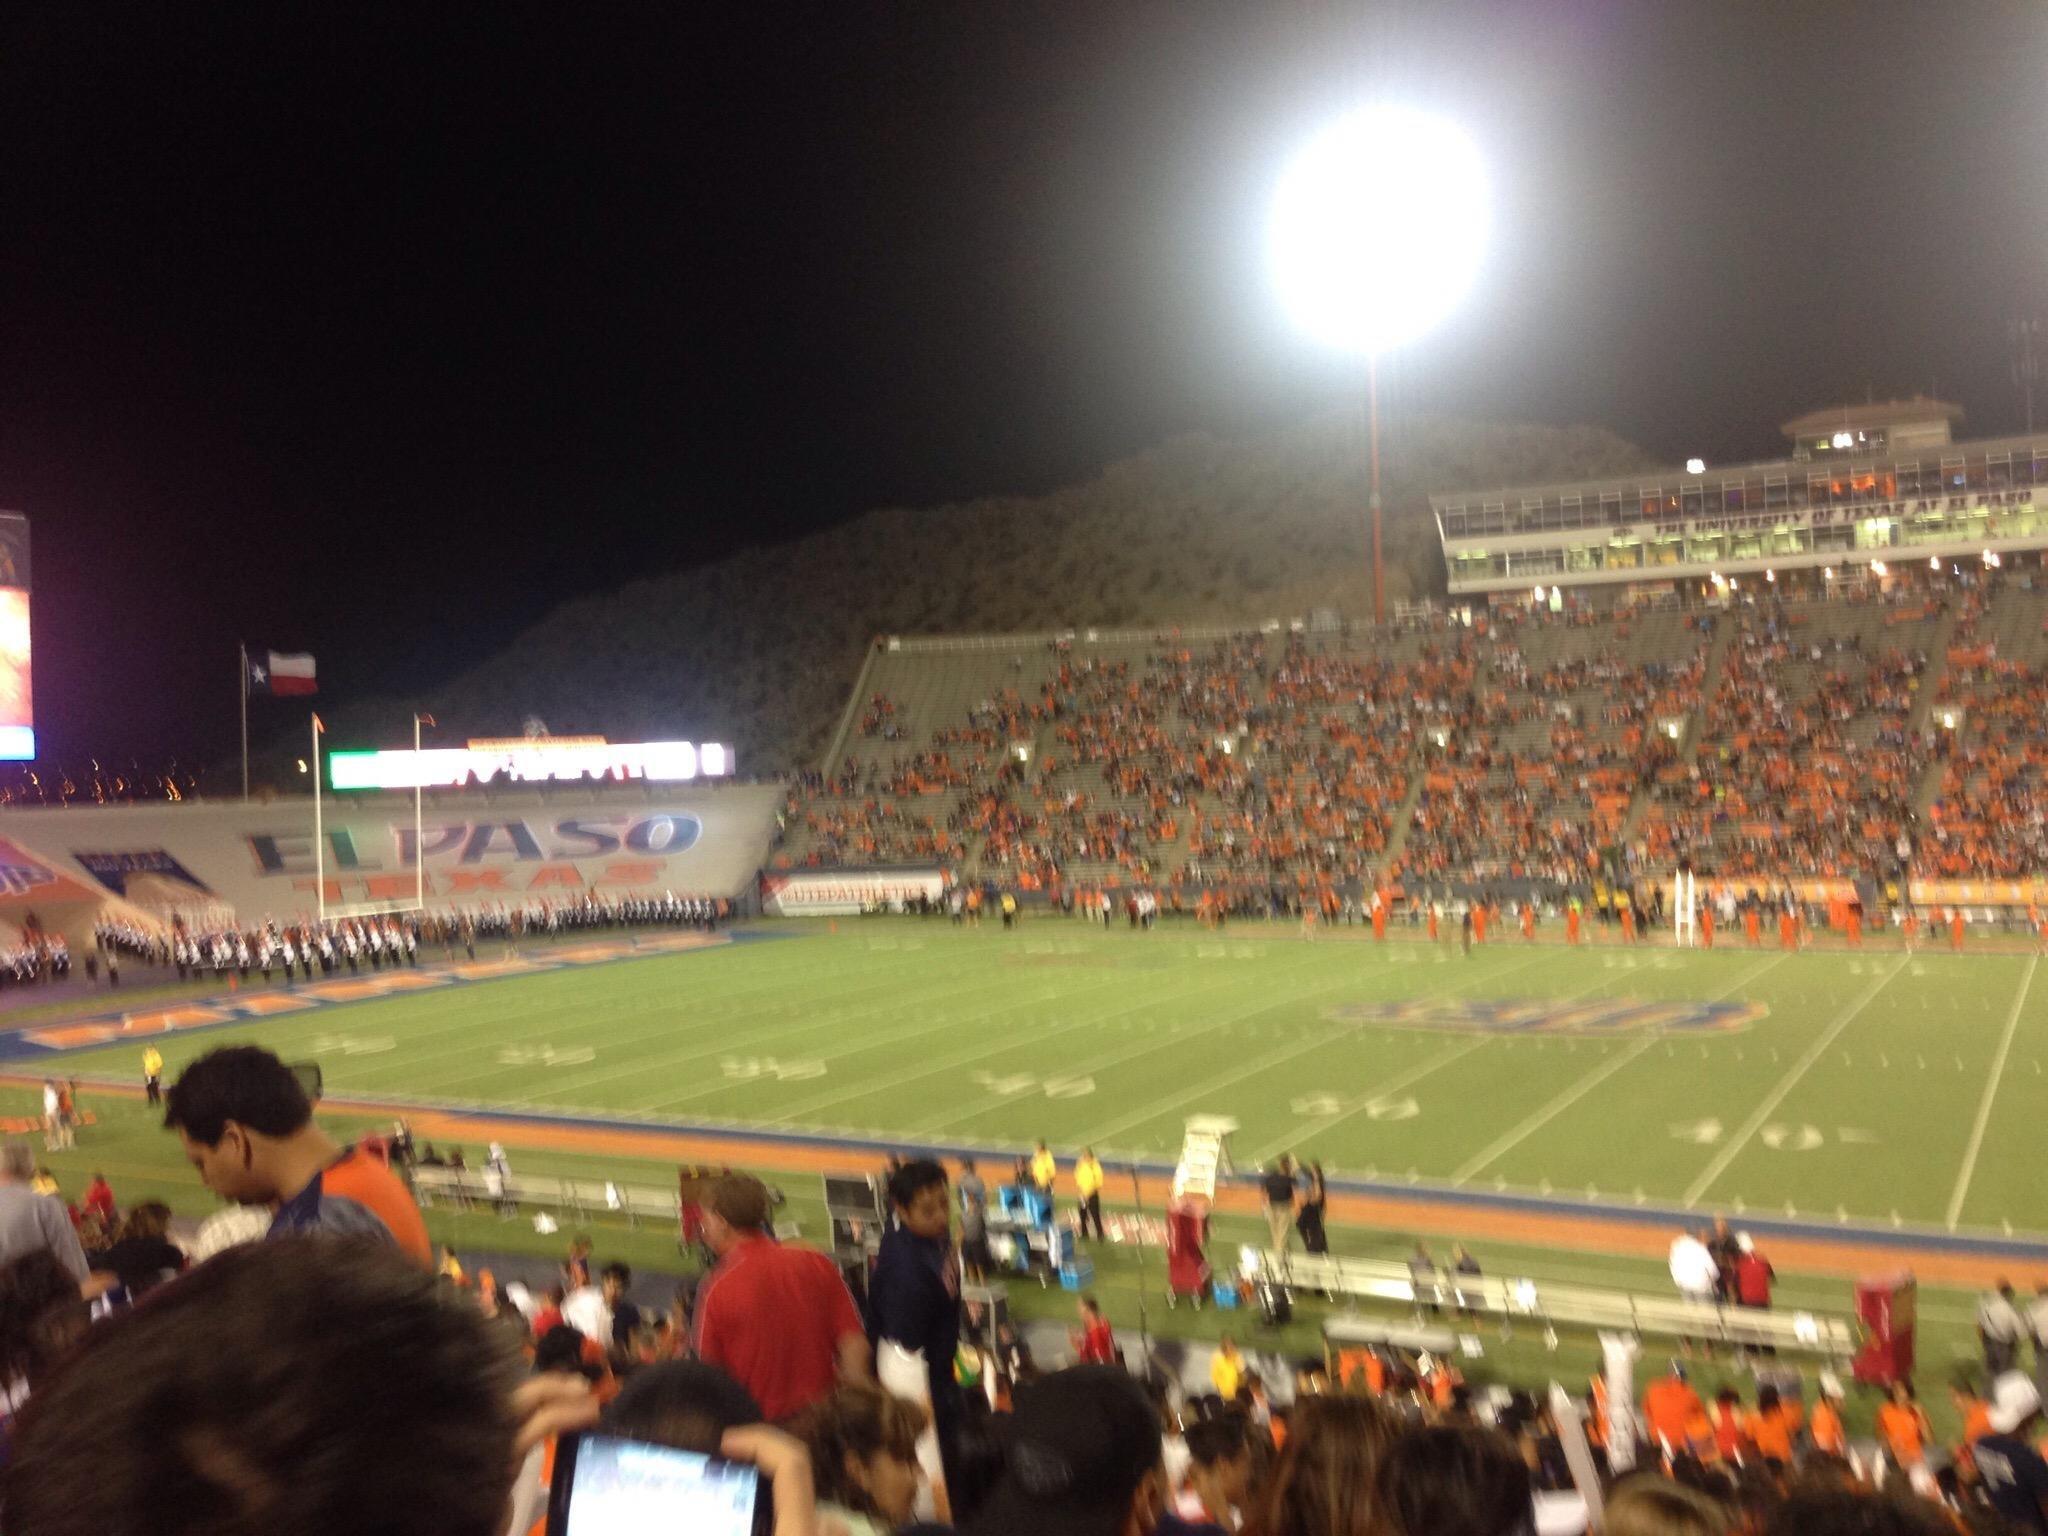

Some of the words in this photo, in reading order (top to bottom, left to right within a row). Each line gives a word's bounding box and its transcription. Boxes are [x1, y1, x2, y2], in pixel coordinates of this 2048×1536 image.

[1695, 512, 1802, 531] UNIVERSITY
[1977, 490, 2032, 506] PASO
[248, 826, 382, 877] EL
[391, 809, 703, 865] PASO
[293, 858, 667, 900] TEXAS
